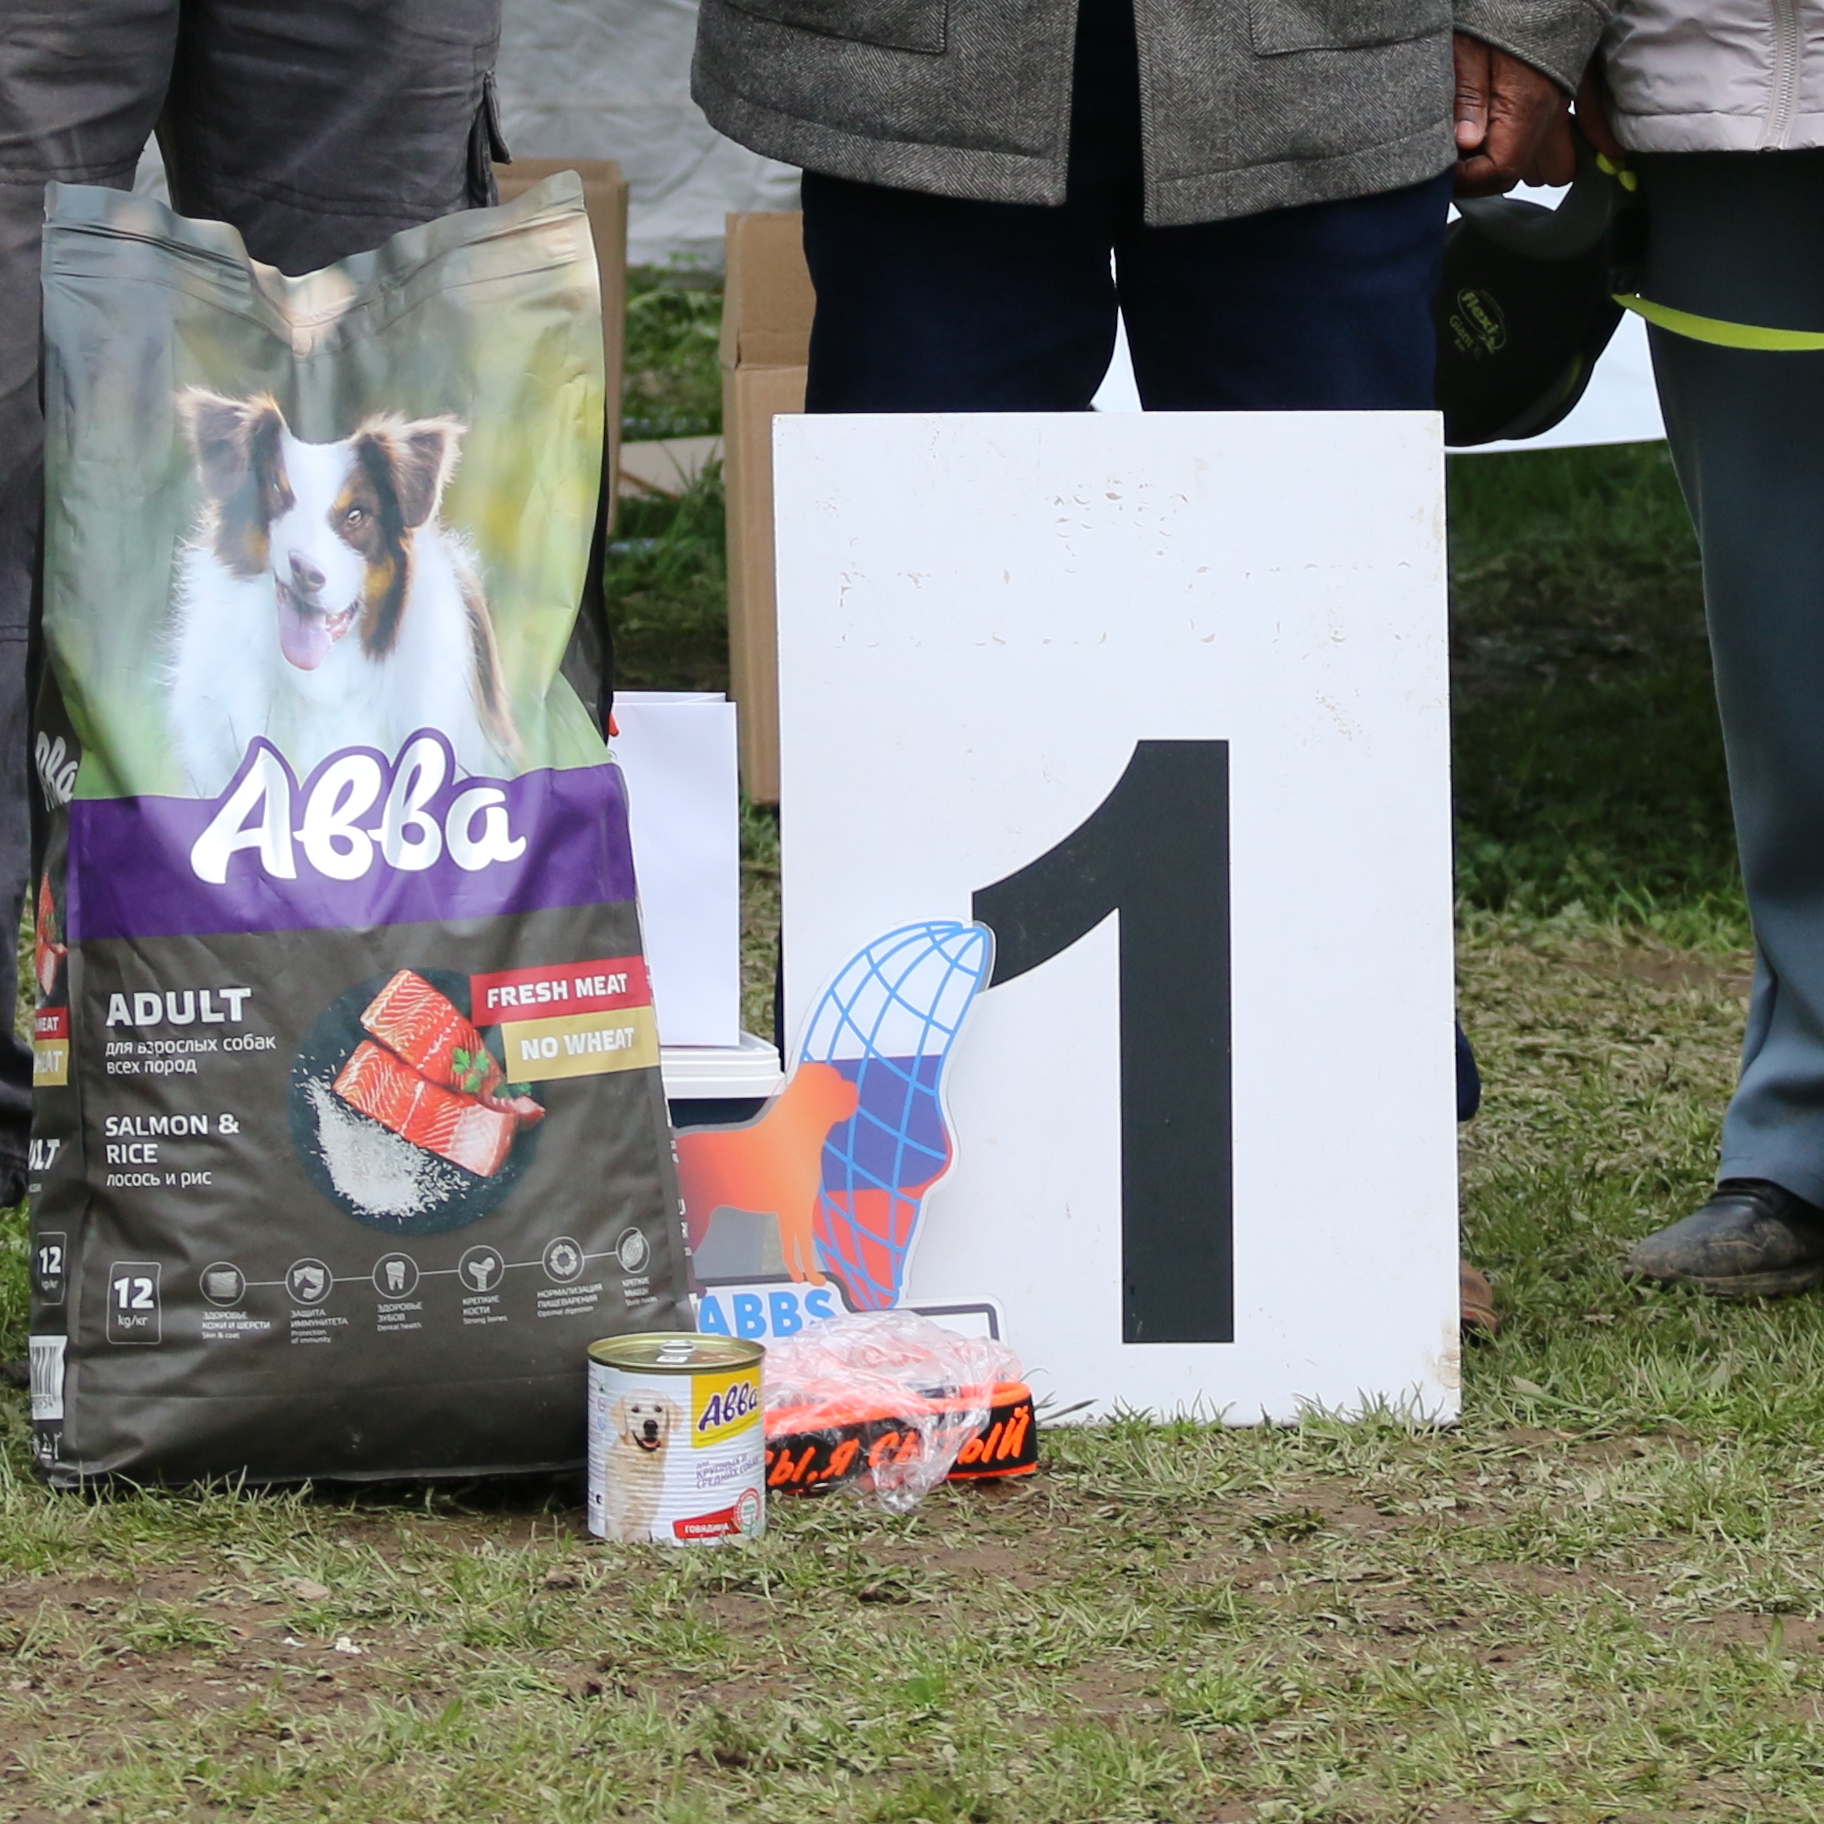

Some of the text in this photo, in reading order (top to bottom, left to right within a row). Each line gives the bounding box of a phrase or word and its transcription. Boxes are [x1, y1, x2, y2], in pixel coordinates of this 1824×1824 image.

[486, 973, 629, 1009] FRESH MEAT
[105, 987, 252, 1026] ADULT
[105, 1033, 277, 1059] для взрослых собак
[520, 1027, 635, 1061] NO WHEAT
[972, 740, 1234, 1343] 1
[107, 1059, 197, 1076] всех пород
[105, 1113, 240, 1137] SALMON &
[106, 1143, 159, 1165] RICE
[106, 1171, 212, 1188] лосось и рис
[39, 1245, 62, 1275] 12
[113, 1276, 155, 1310] 12
